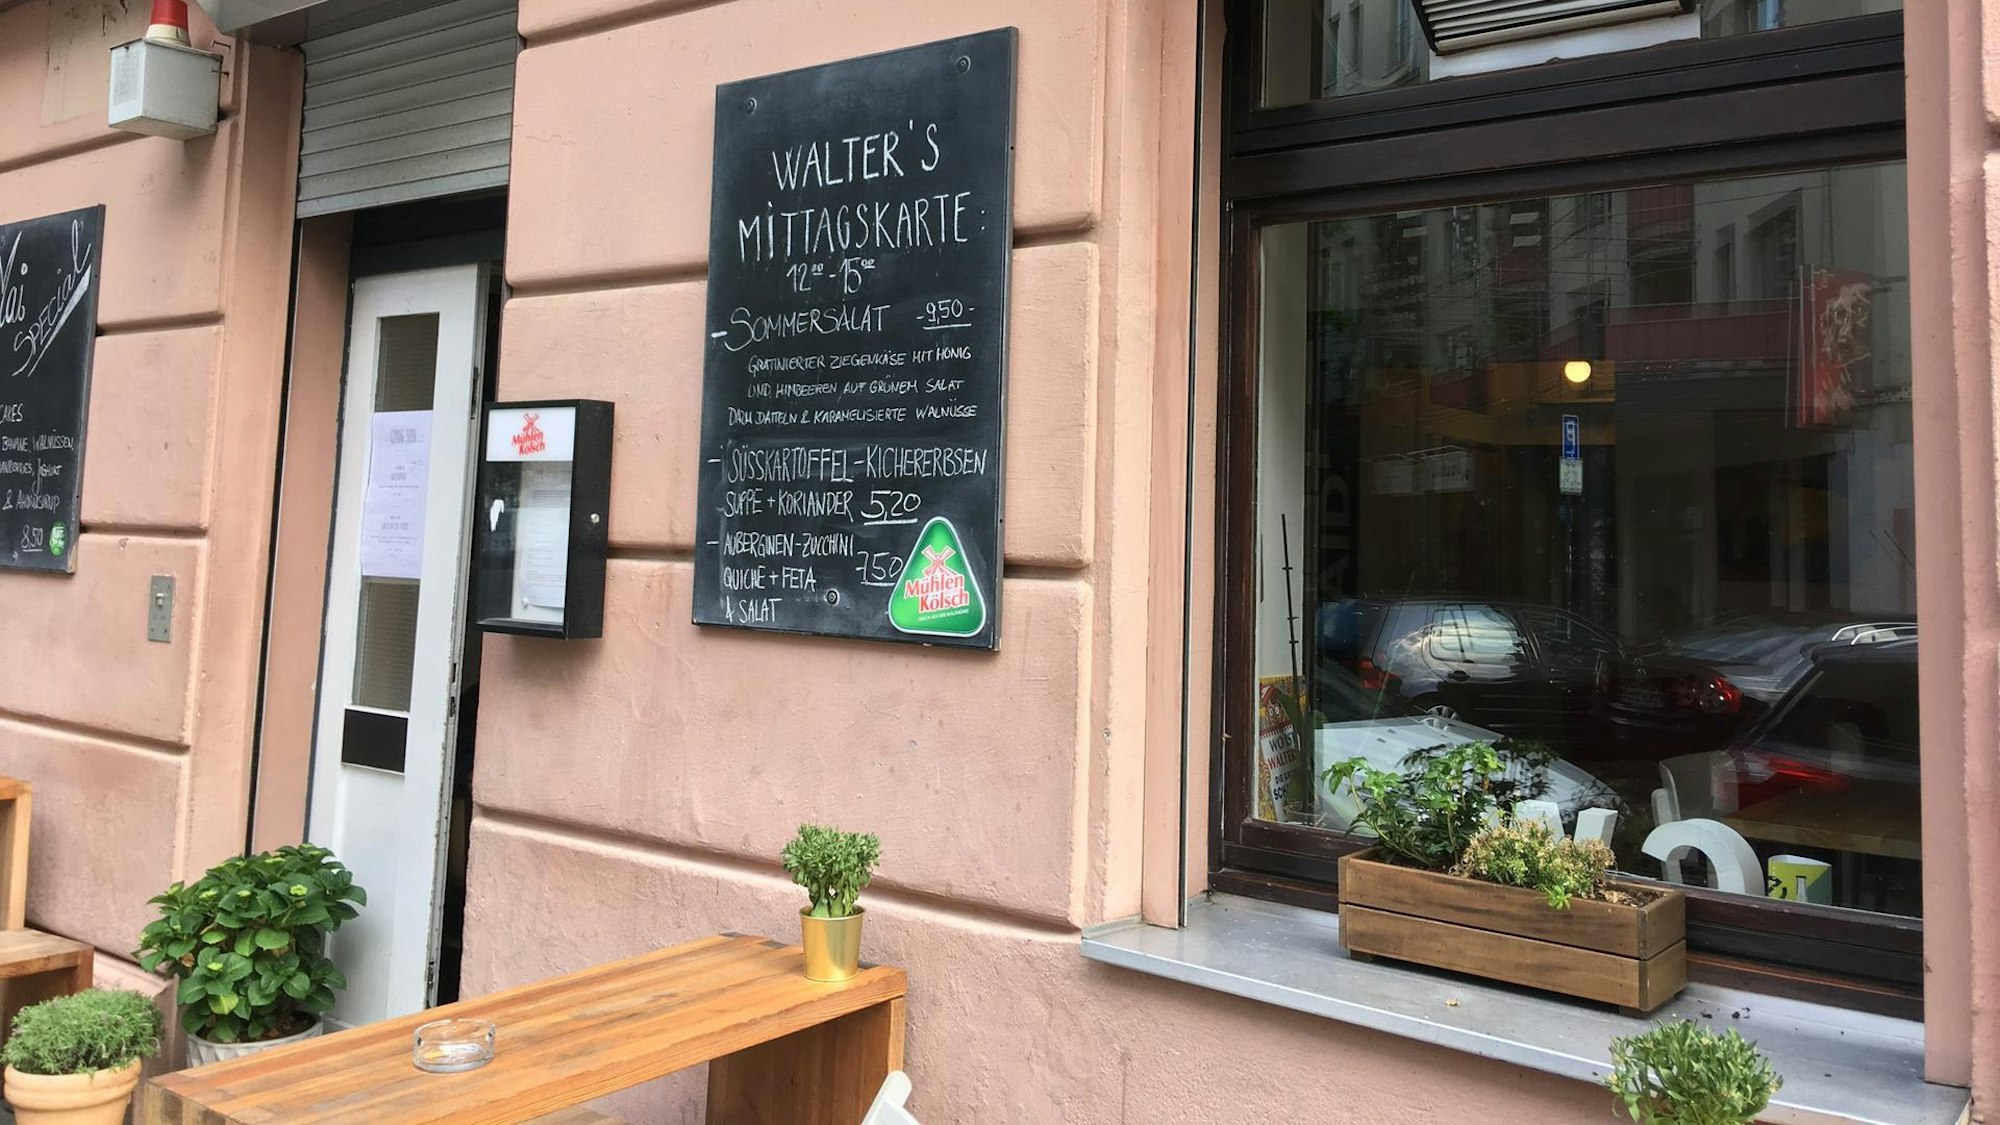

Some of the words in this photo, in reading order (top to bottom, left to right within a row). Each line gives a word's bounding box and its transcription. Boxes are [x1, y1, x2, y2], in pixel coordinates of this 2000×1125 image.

[772, 118, 940, 191] WALTER'S
[747, 353, 826, 377] GRATINIERTER
[829, 349, 906, 371] ZIEGENKÄSE
[912, 349, 935, 364] MIT
[936, 346, 972, 361] HONIG
[775, 382, 838, 398] HIMBEEREN
[843, 381, 868, 394] AUF
[869, 374, 919, 395] GRÜNEM
[925, 377, 966, 394] SALAT
[755, 410, 798, 425] DATTELN
[813, 408, 907, 425] KARAMELISIERTE
[915, 398, 978, 420] WALNÜSSE
[723, 488, 764, 518] SUPPE
[777, 488, 854, 523] KORIANDER
[722, 564, 767, 591] QUICHE
[781, 565, 818, 592] FETA
[906, 573, 964, 600] Mühlen
[738, 598, 783, 624] SALAT
[919, 588, 969, 613] Kölsch
